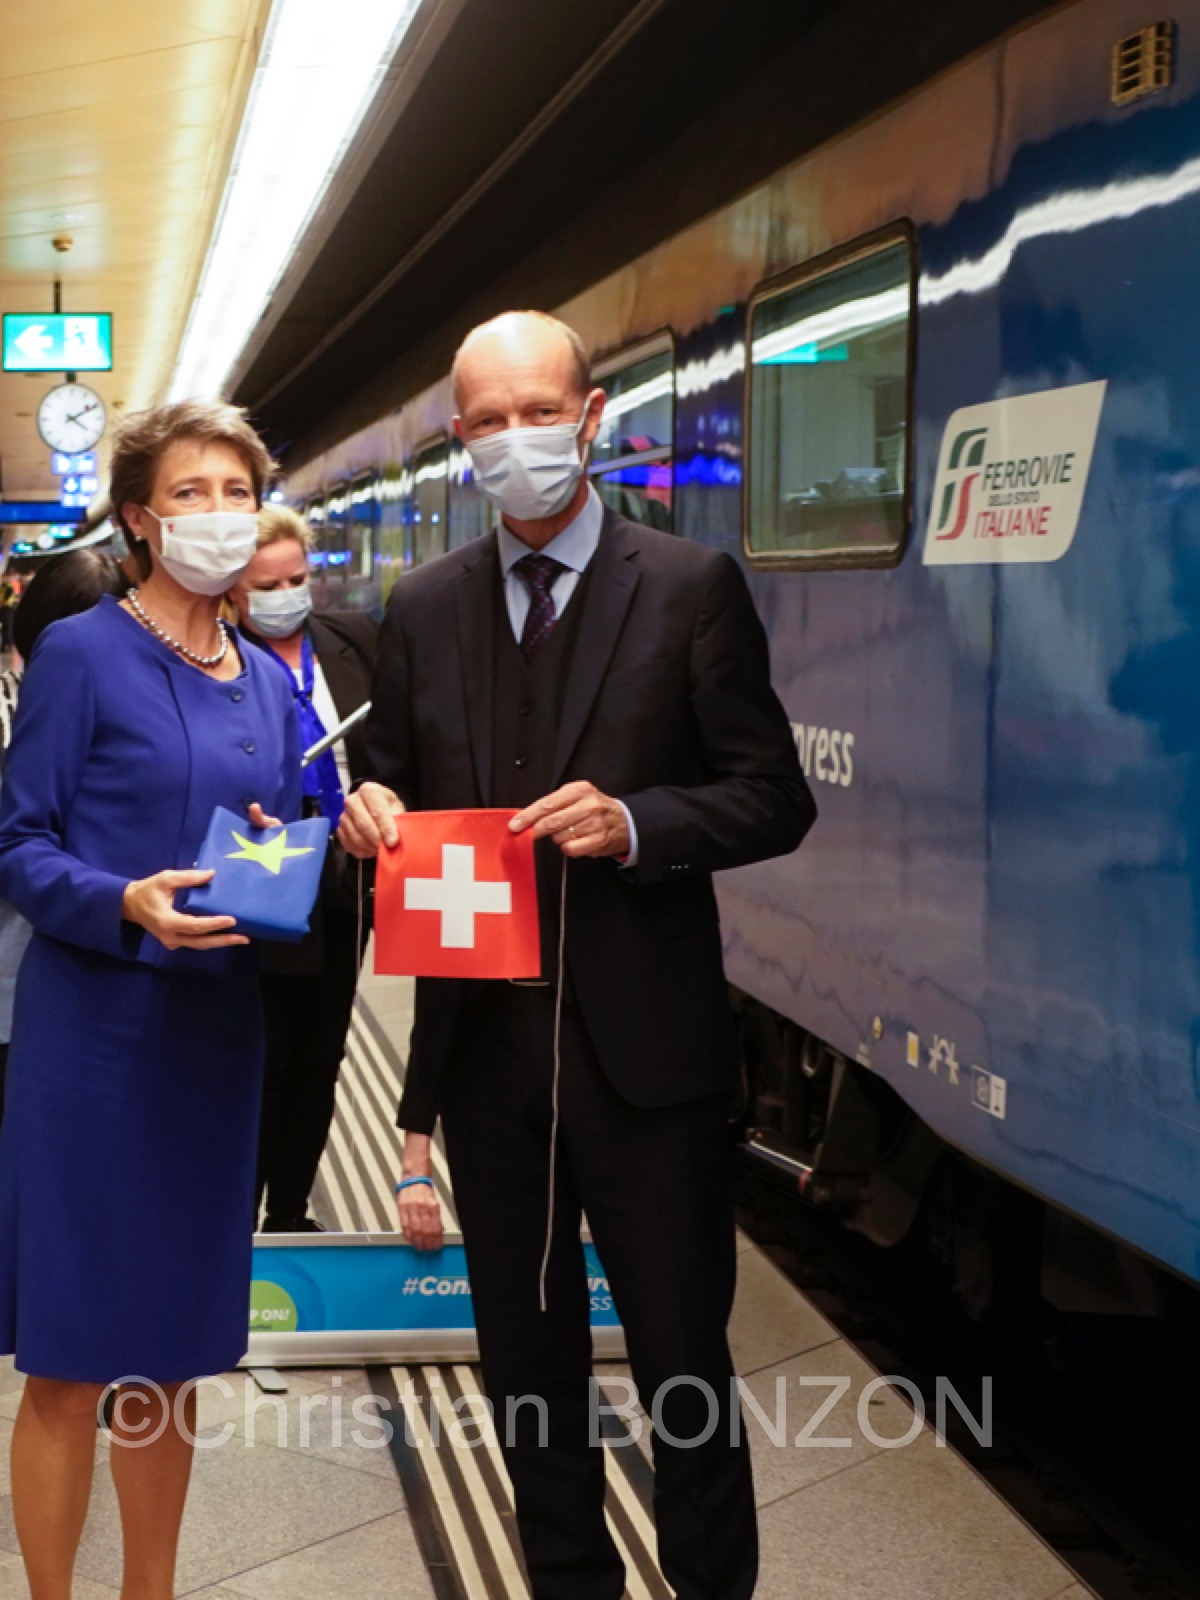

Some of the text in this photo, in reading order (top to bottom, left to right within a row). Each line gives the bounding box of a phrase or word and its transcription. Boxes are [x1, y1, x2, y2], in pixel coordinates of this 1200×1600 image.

[981, 452, 1075, 491] FERROVIE
[972, 505, 1053, 538] ITALIANE
[401, 1275, 471, 1296] #Con
